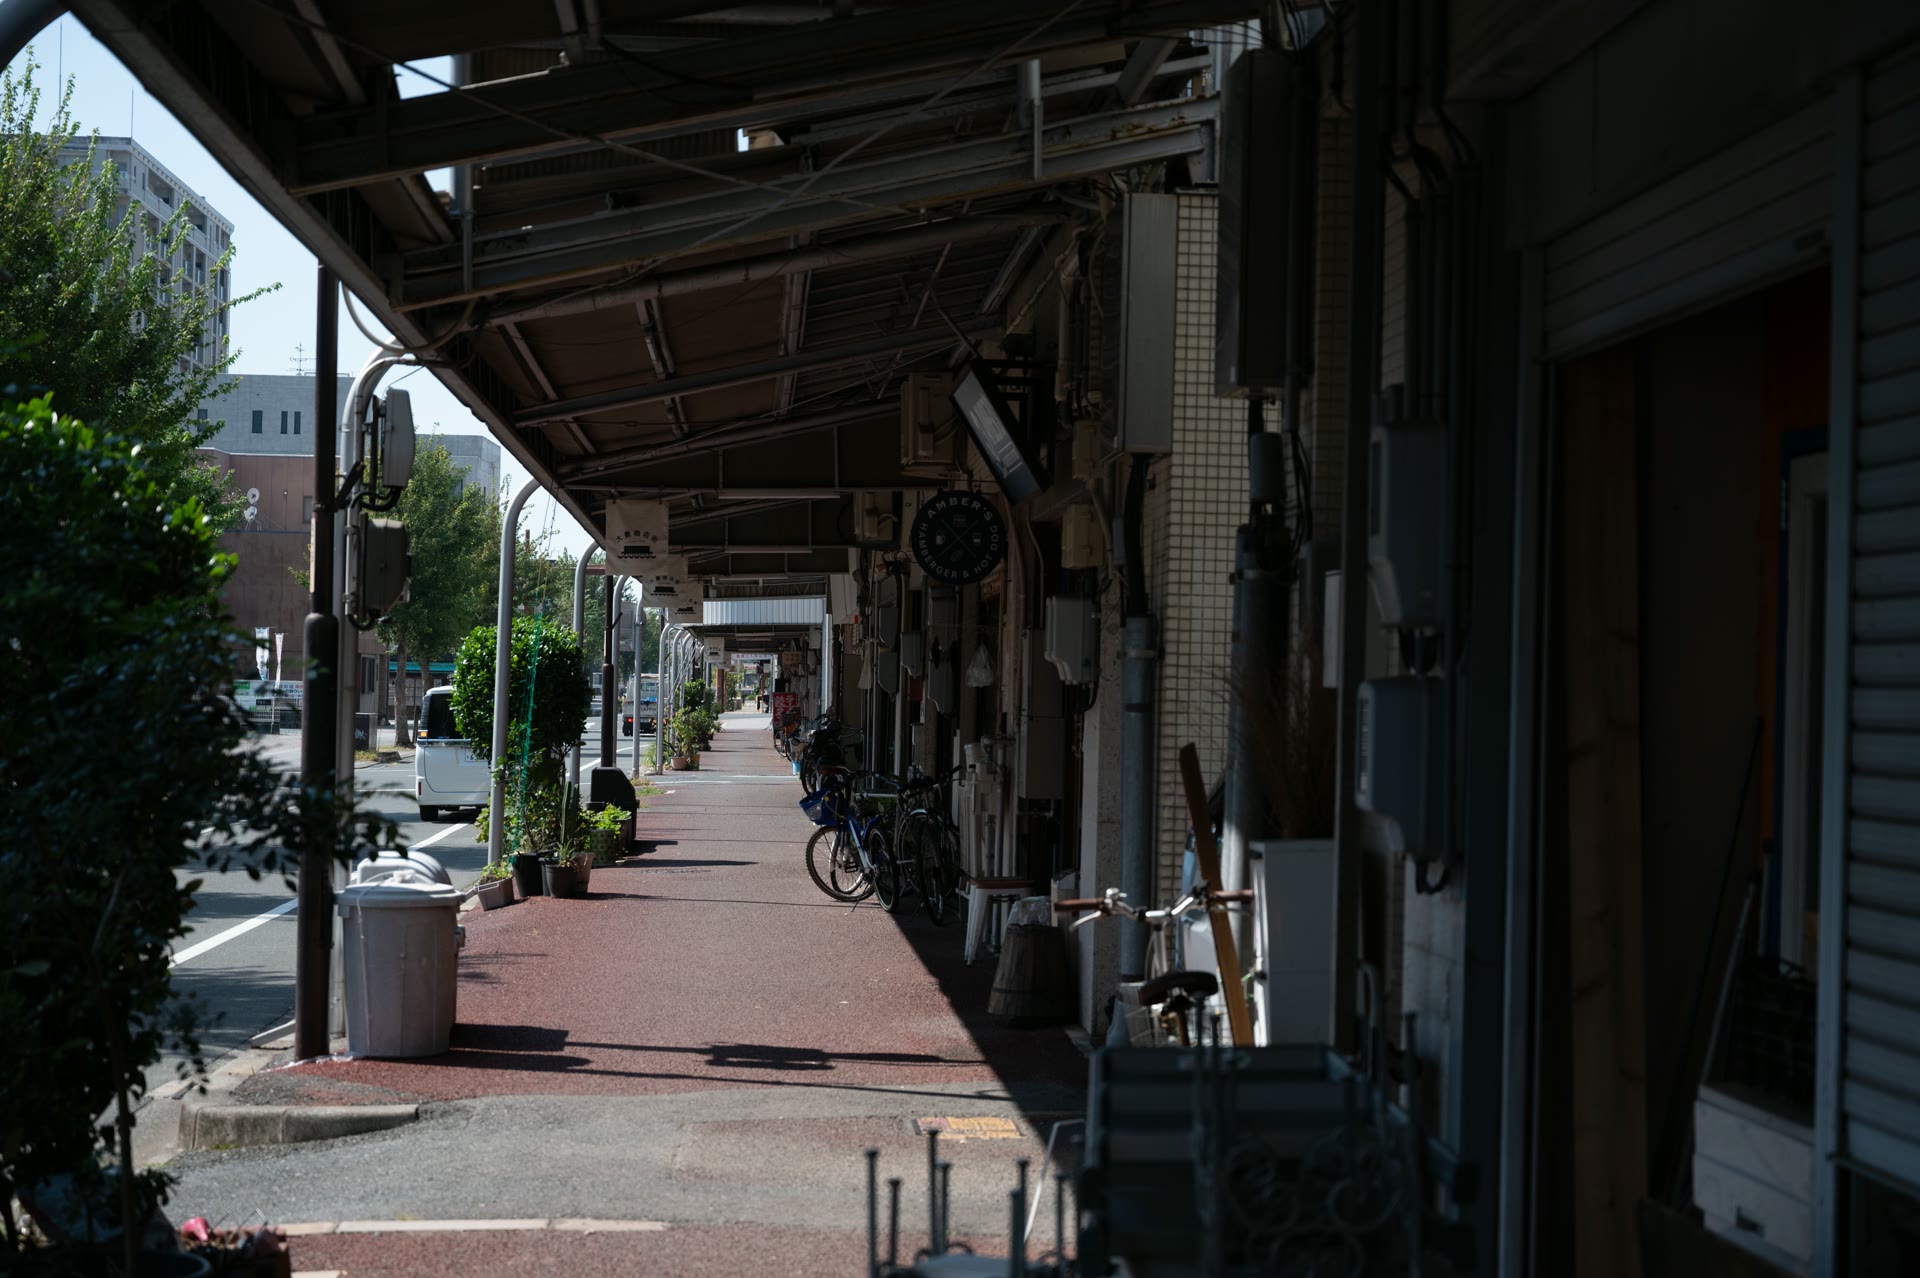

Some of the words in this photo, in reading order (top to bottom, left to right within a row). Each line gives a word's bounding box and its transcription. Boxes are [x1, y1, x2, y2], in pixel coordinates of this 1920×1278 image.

[927, 497, 994, 521] AMBER'S
[917, 522, 958, 579] HAMBERGER
[962, 570, 970, 578] &
[973, 553, 993, 575] HOT
[989, 524, 1000, 552] DOG
